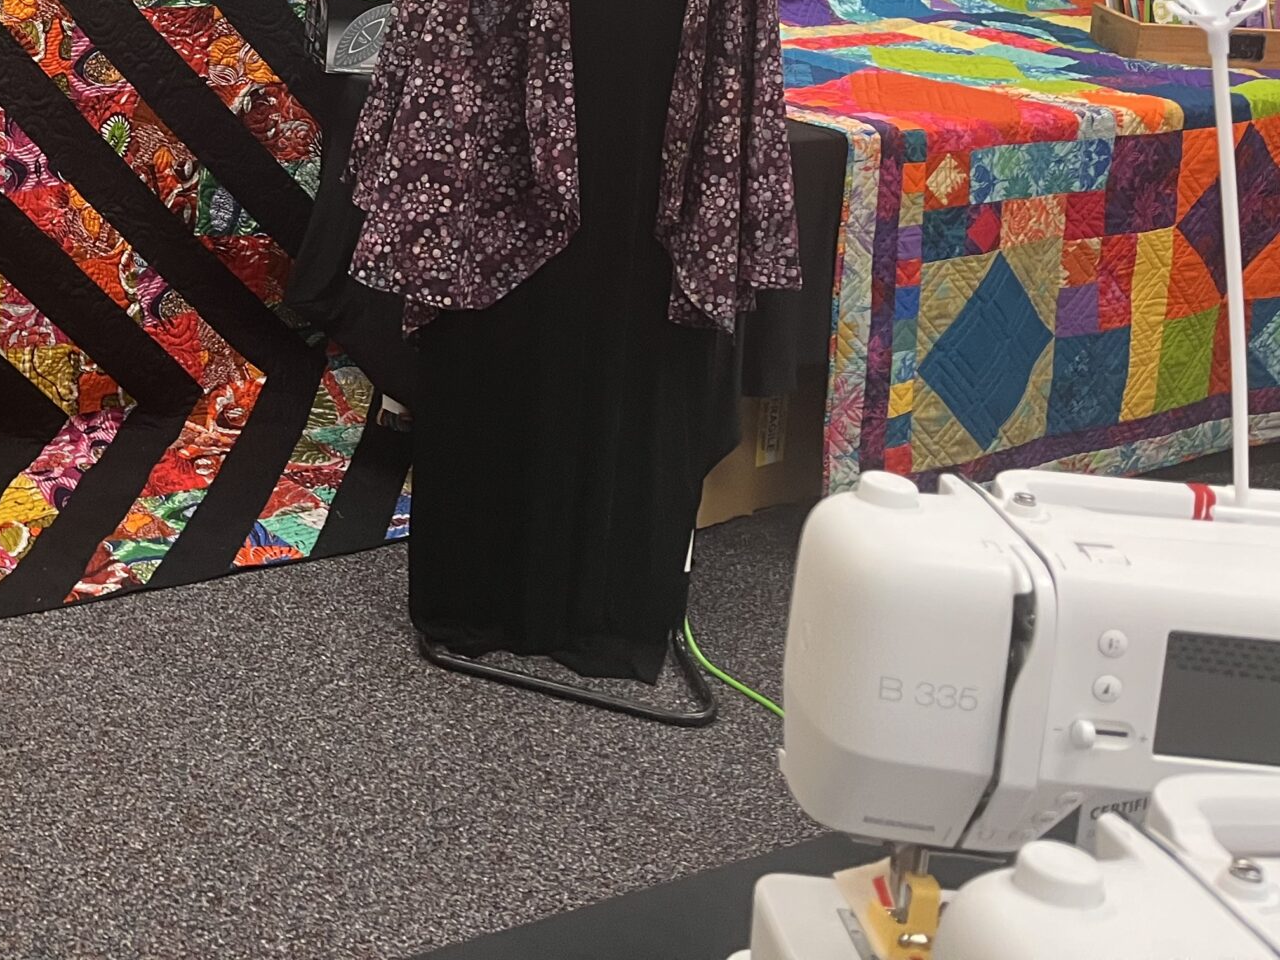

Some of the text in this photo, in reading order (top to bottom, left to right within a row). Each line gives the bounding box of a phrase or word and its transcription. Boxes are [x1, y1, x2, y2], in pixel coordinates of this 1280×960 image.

[879, 676, 979, 712] B 335
[1089, 796, 1149, 821] CERTIFI
